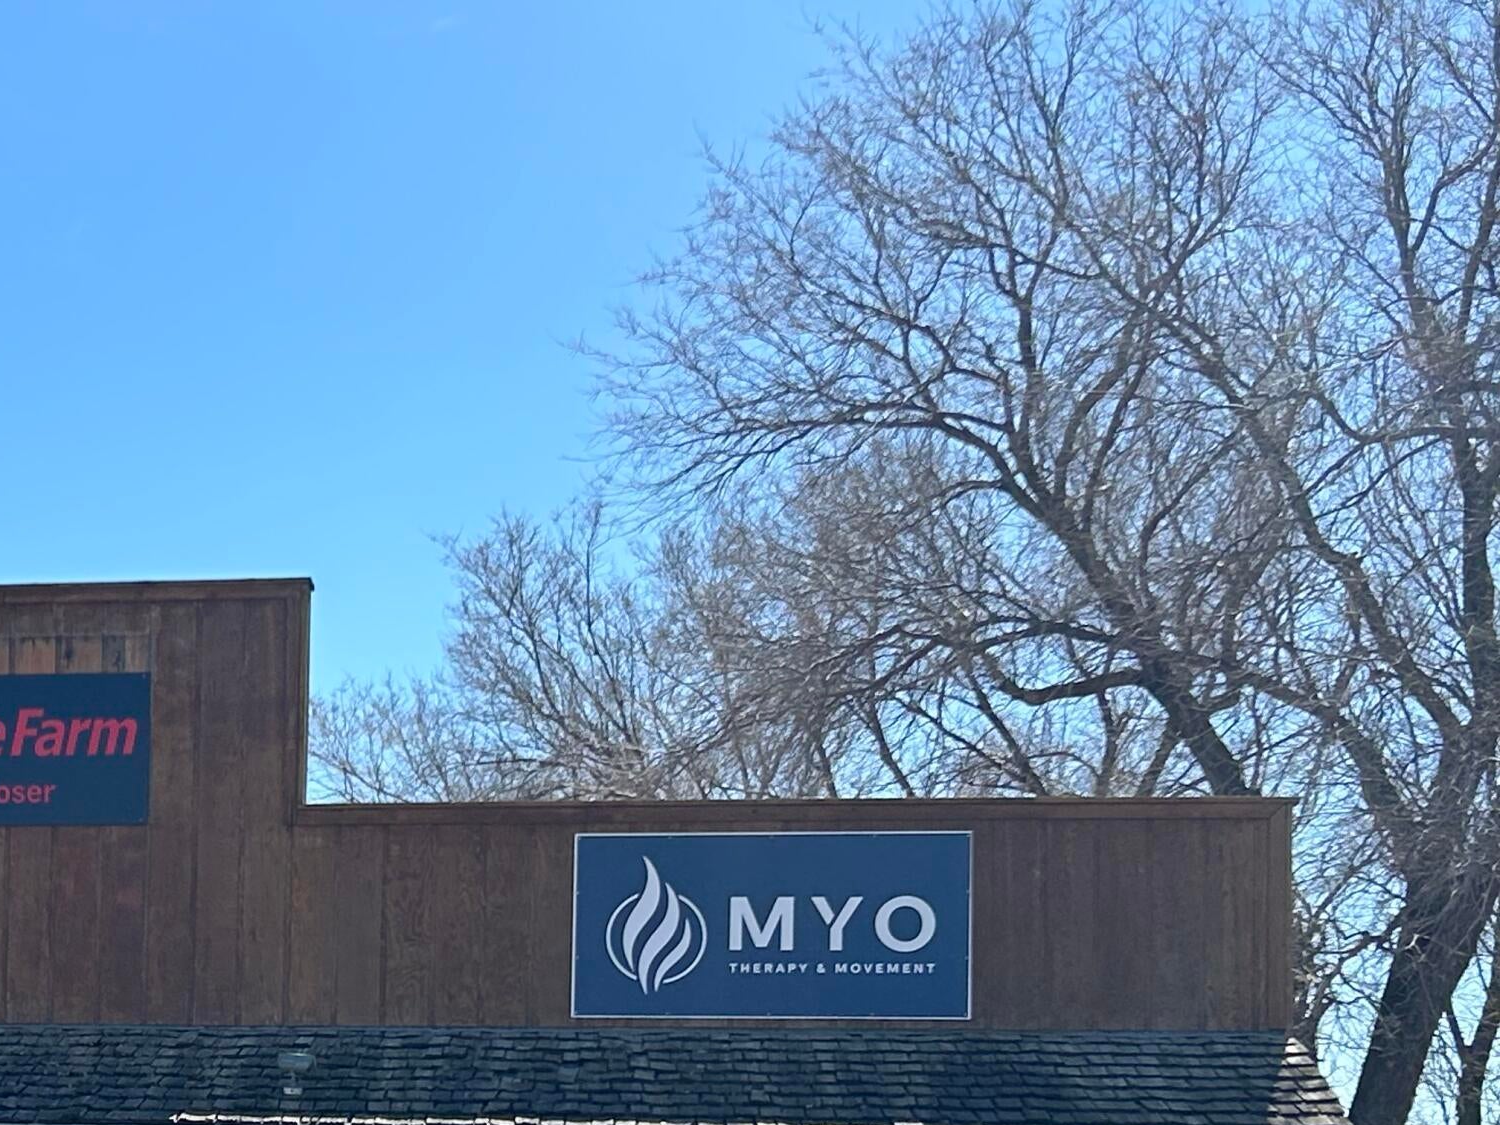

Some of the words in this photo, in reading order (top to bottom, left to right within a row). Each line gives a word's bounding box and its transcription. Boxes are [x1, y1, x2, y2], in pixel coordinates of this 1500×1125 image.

[728, 895, 937, 953] MYO
[728, 962, 808, 974] THERAPY
[815, 962, 827, 974] &
[834, 962, 937, 974] MOVEMENT
